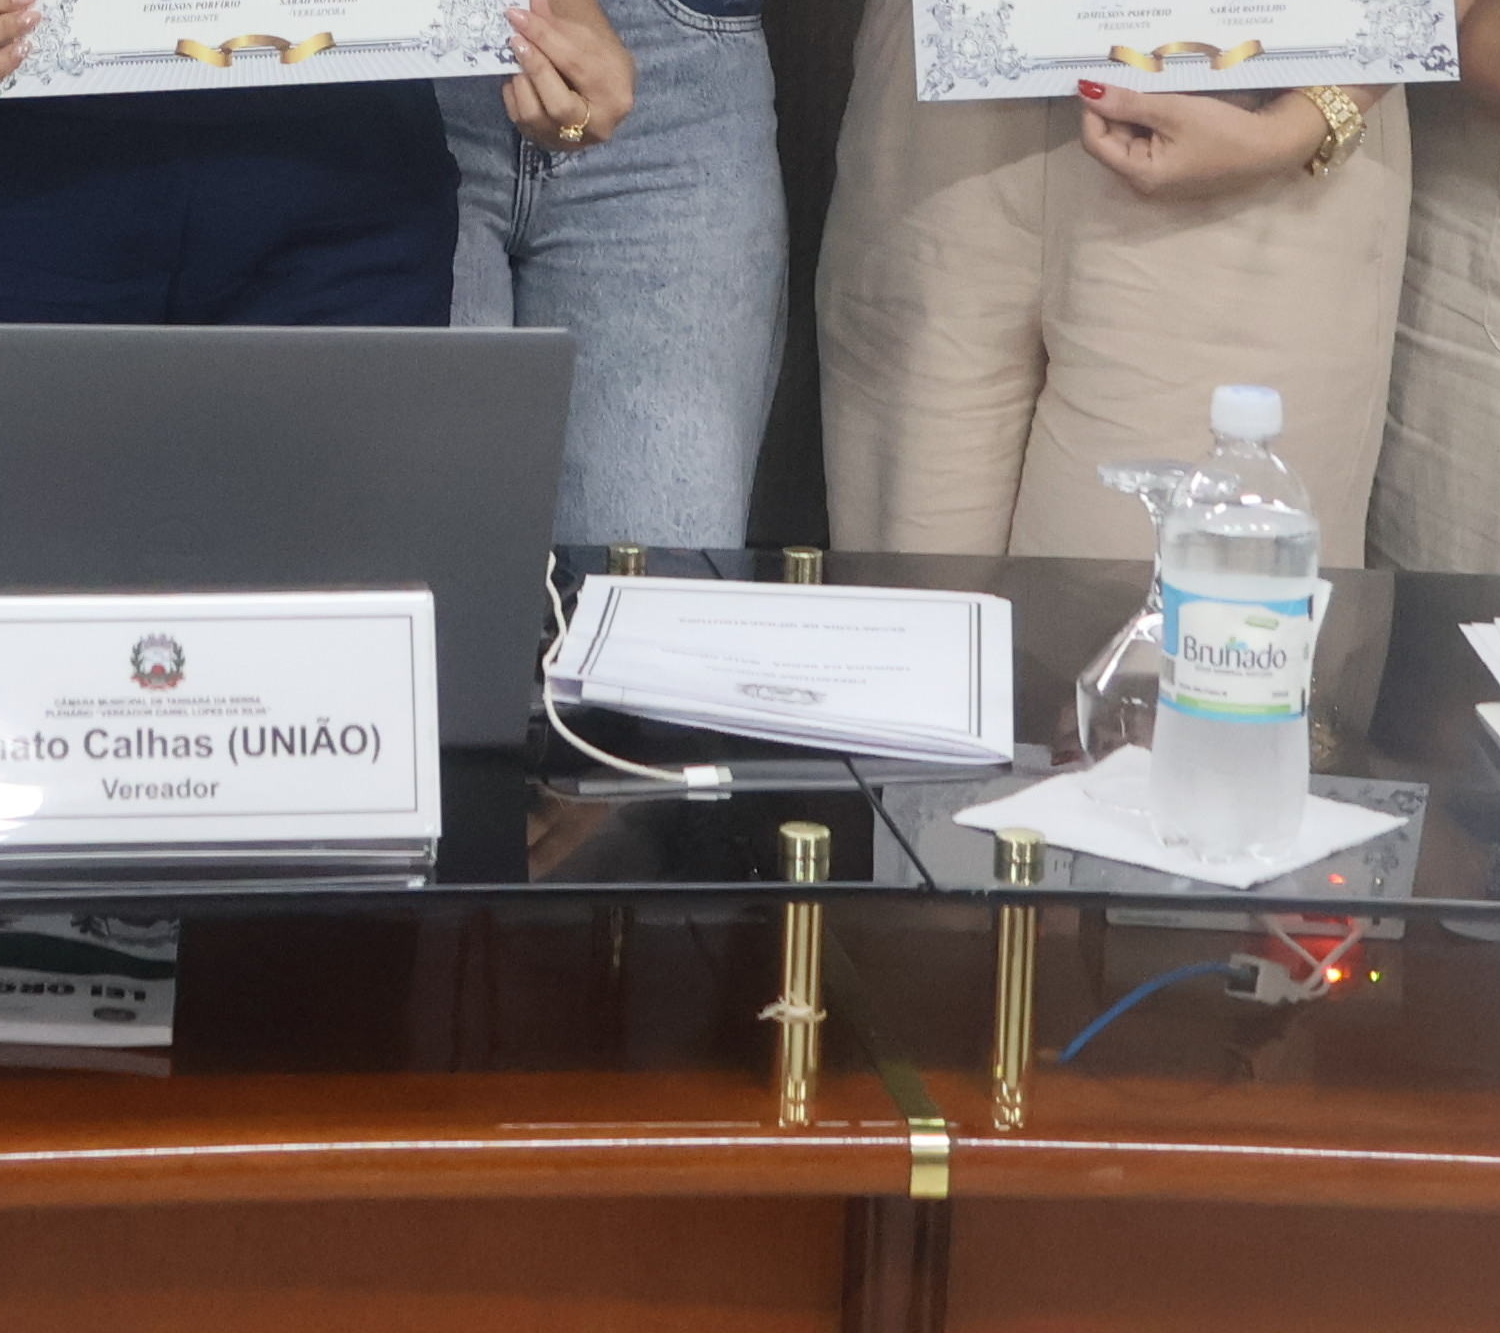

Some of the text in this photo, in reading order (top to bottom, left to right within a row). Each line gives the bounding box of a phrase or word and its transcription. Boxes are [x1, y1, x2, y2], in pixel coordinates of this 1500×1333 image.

[1183, 634, 1287, 670] Brunado
[83, 726, 214, 760] Calhas
[228, 717, 382, 765] (UNIÃO)
[101, 776, 221, 801] Vereador
